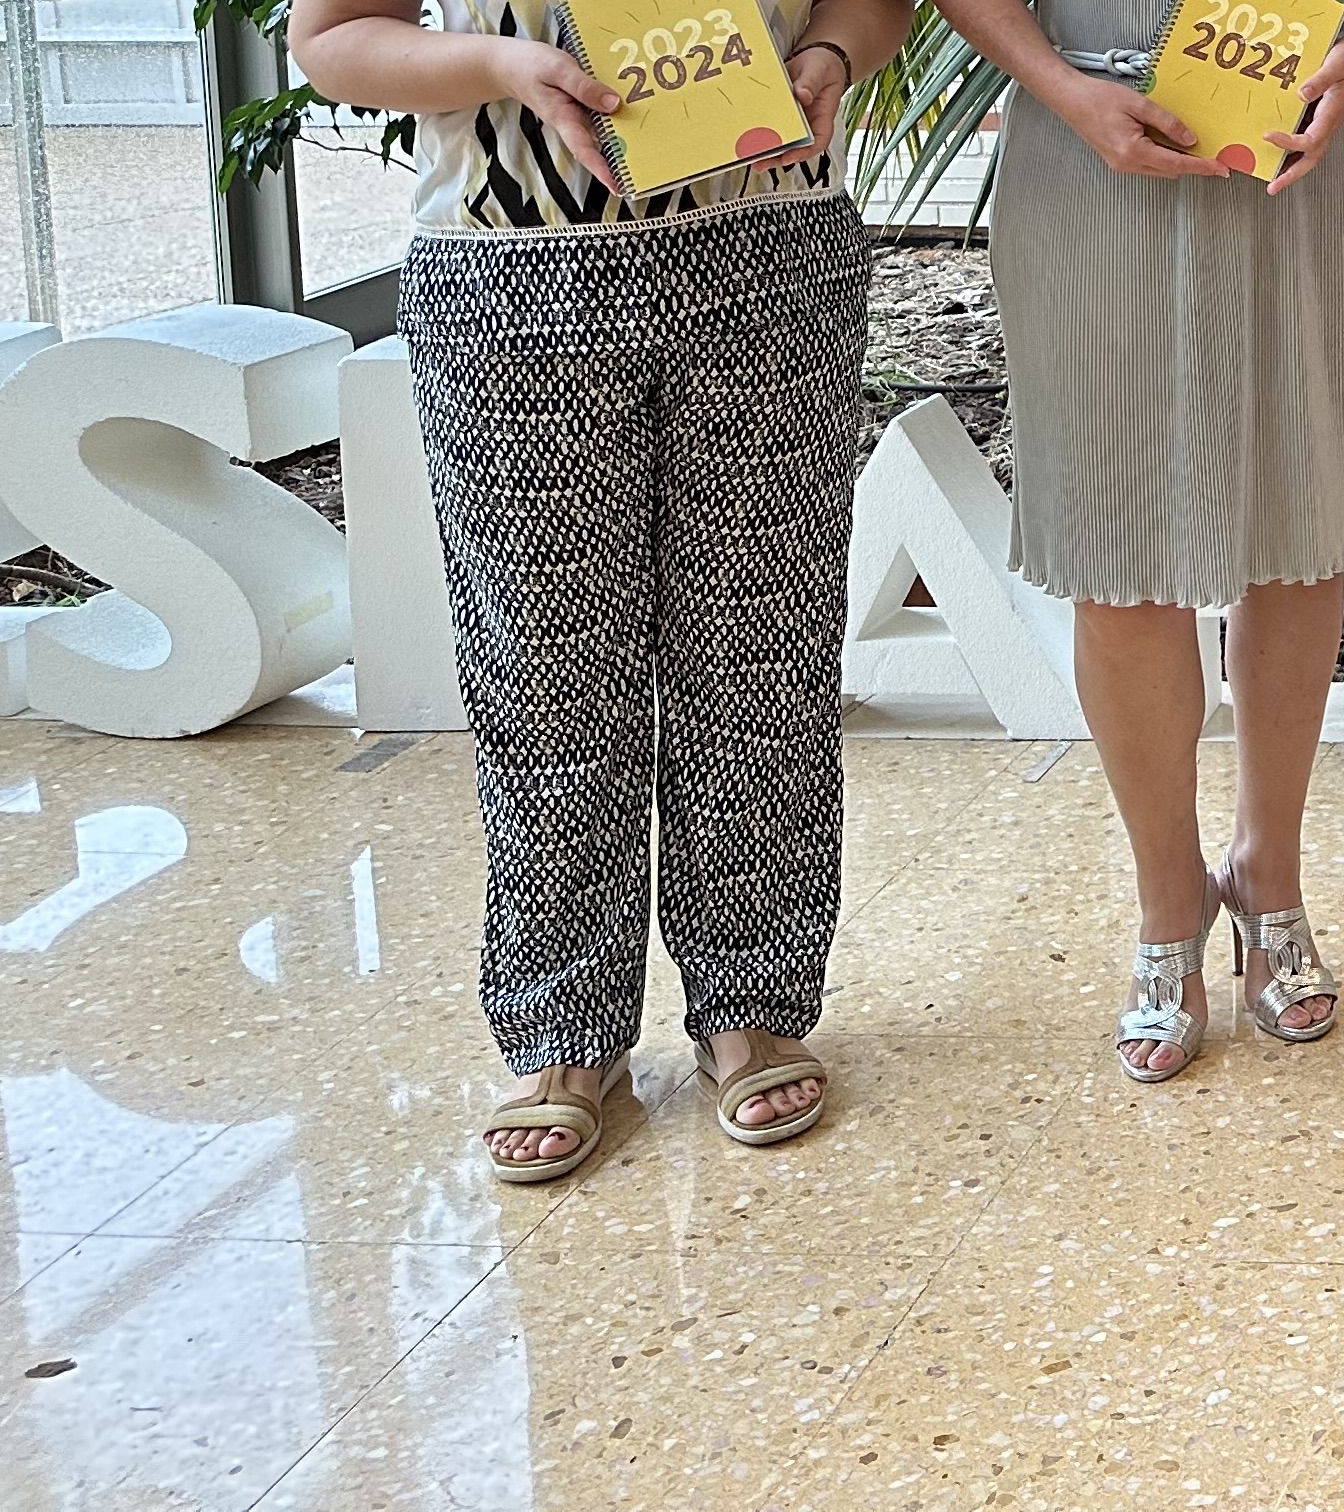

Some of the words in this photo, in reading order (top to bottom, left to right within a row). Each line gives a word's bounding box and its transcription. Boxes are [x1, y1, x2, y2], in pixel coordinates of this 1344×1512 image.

[609, 9, 738, 75] 2023
[617, 33, 752, 104] 2024
[1182, 22, 1302, 90] 2024
